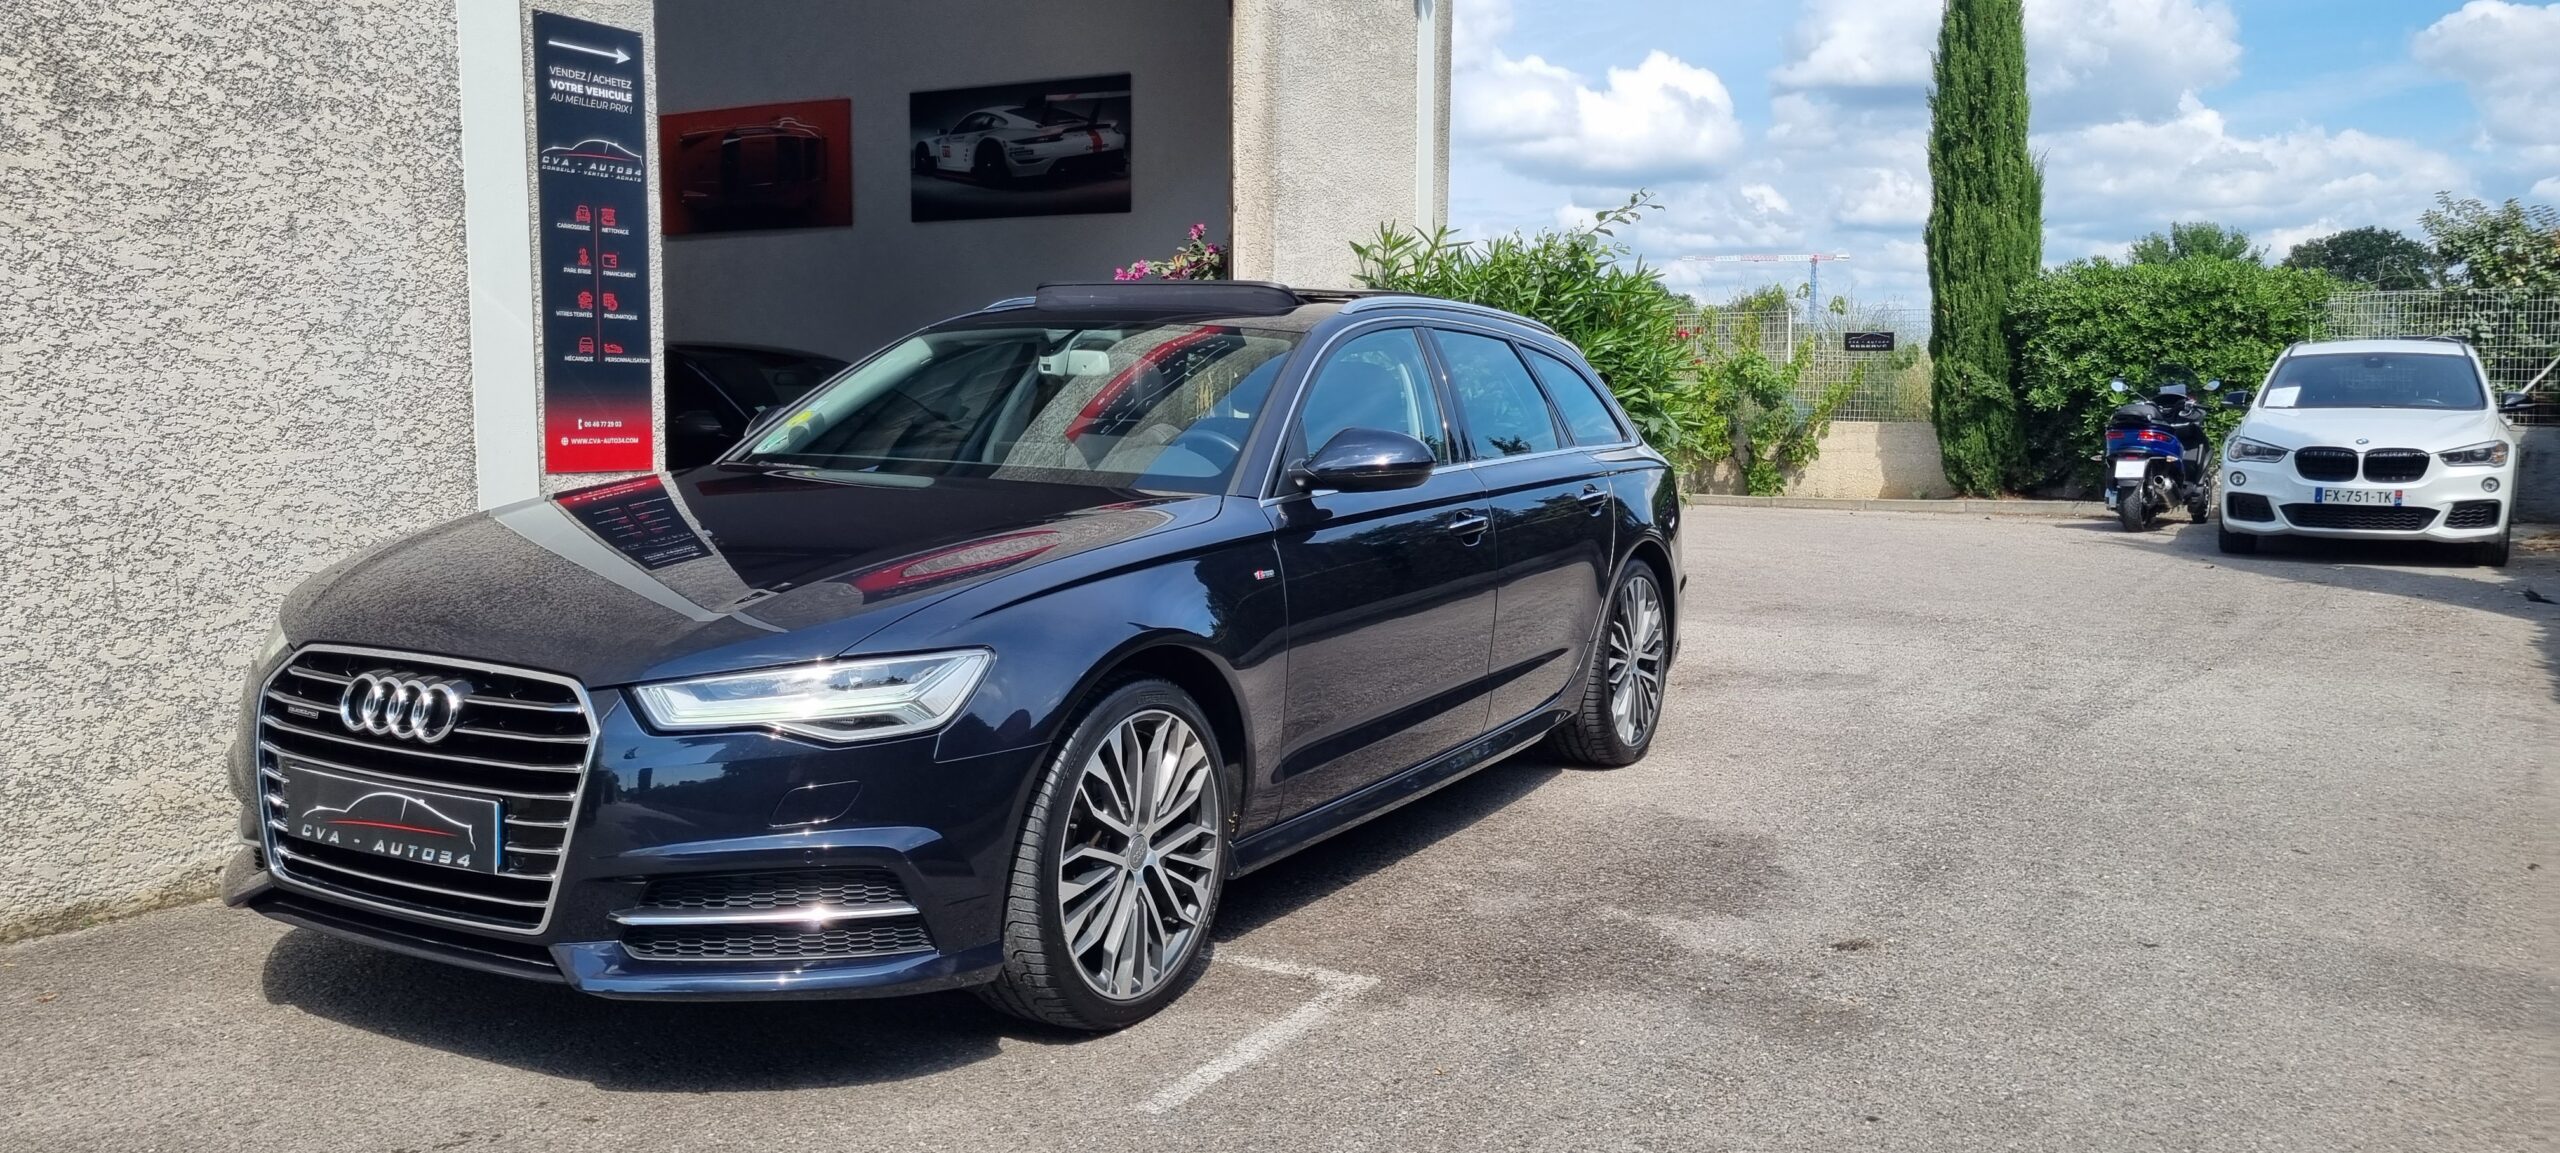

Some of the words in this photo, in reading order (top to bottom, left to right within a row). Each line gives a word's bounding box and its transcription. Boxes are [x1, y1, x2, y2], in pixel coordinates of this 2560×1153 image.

[549, 65, 587, 81] VENDEZ
[592, 74, 632, 90] ACHETEZ
[549, 79, 584, 94] VOTRE
[585, 85, 633, 103] VEHICULE
[550, 92, 563, 102] AU
[565, 94, 608, 110] MEILLEUR
[609, 102, 629, 114] PRIX
[542, 155, 569, 166] CVA
[2324, 489, 2392, 504] FX-751-TK
[302, 823, 340, 844] CVA
[373, 840, 471, 867] AUTO34
